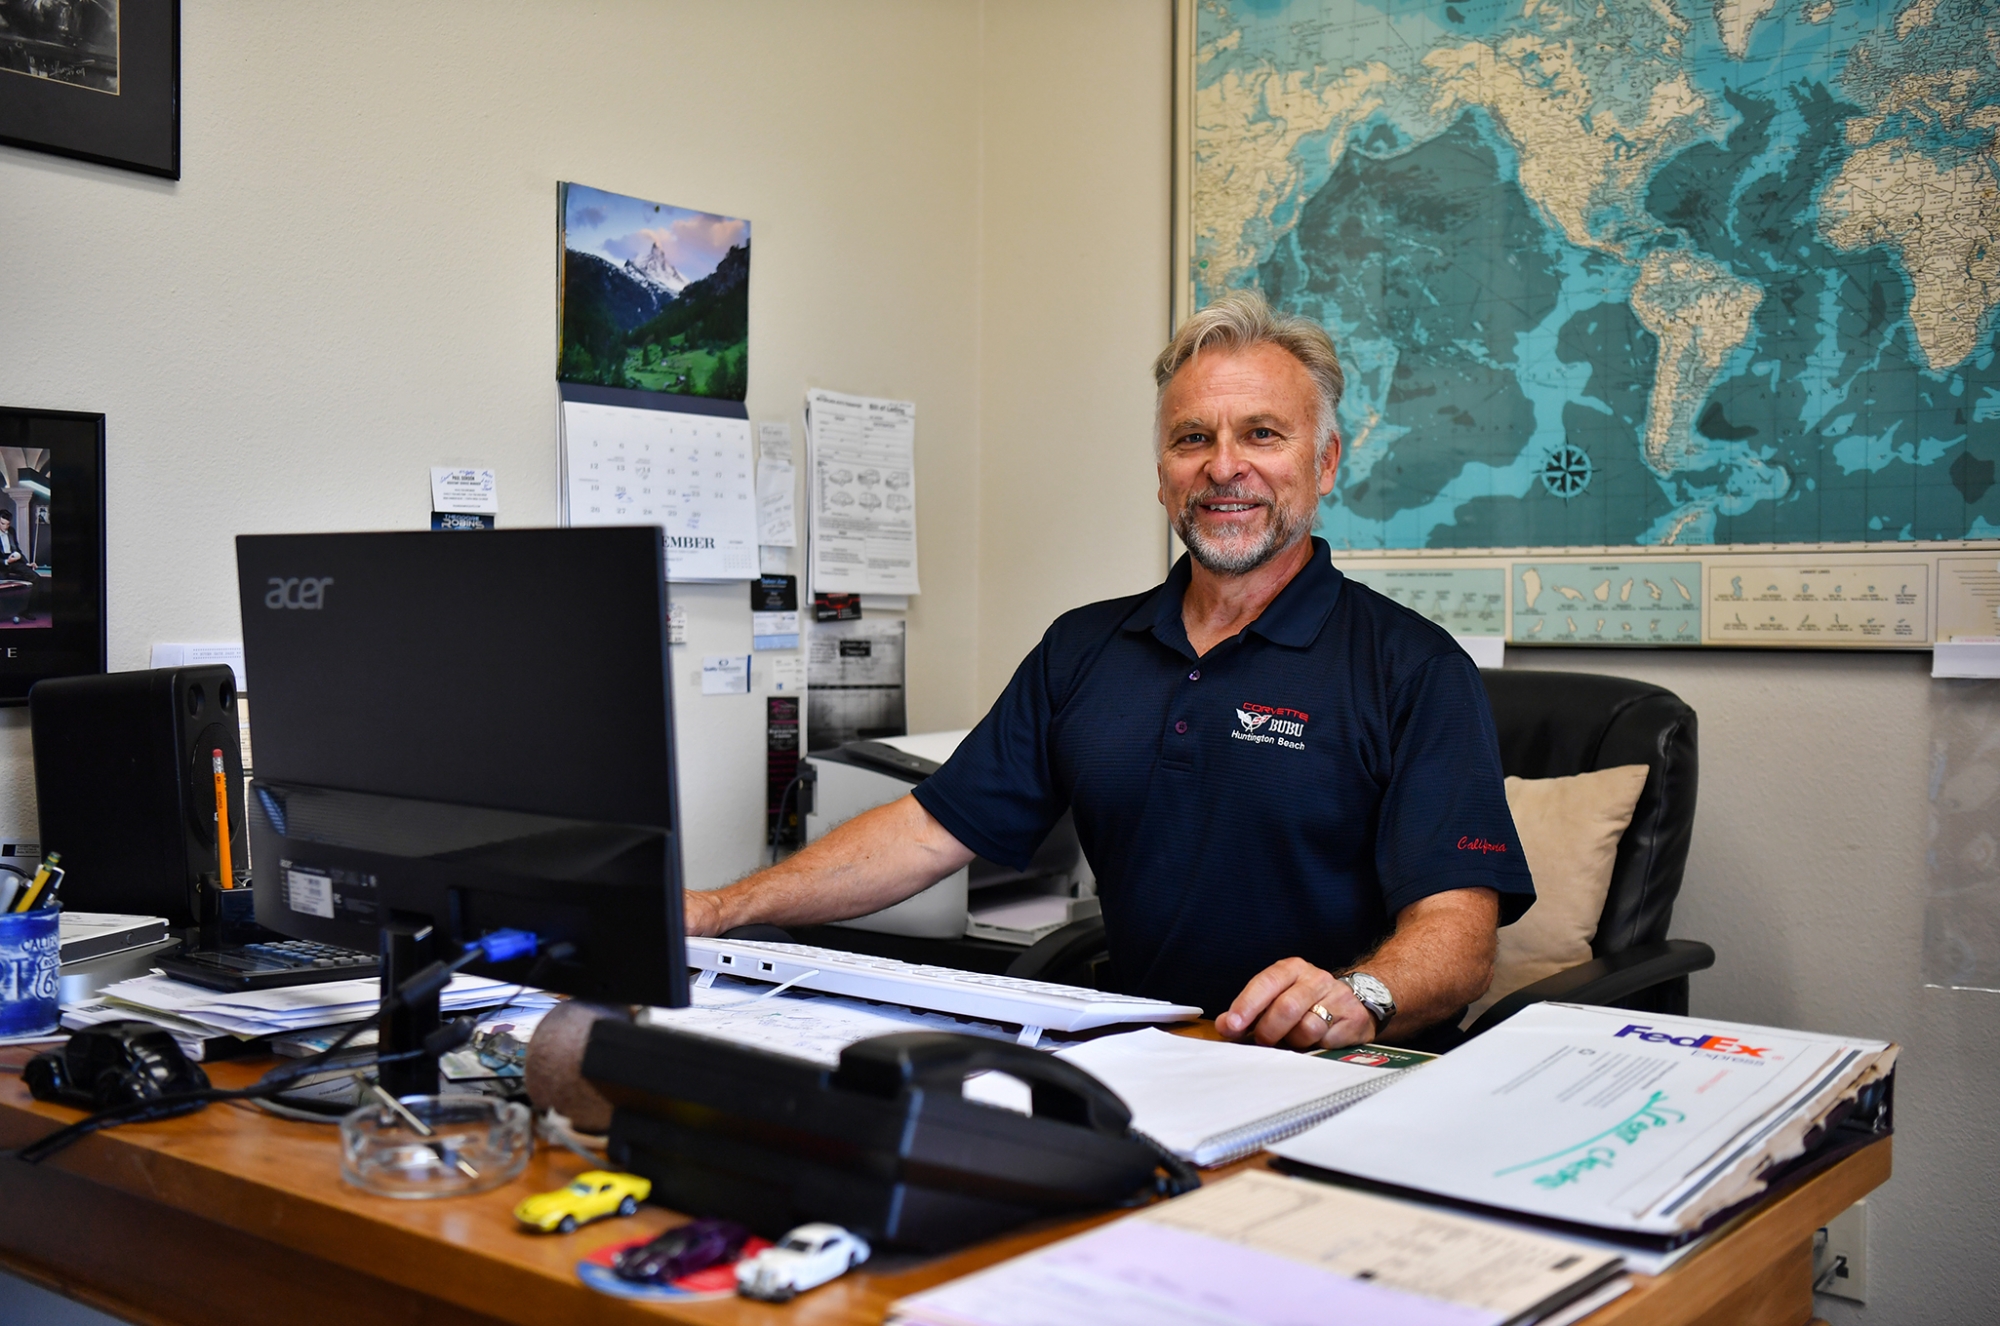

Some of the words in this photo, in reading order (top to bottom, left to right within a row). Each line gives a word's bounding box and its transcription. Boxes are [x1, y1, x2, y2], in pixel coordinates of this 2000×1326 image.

[441, 518, 485, 530] ROBINS
[661, 536, 715, 549] EMBER
[264, 577, 334, 610] acer
[1242, 702, 1309, 723] CORVETTE
[1268, 719, 1304, 737] BUBU
[1231, 730, 1275, 744] Huntington
[1277, 737, 1305, 750] Beach
[1613, 1024, 1775, 1058] FedEx
[1690, 1050, 1765, 1067] Express
